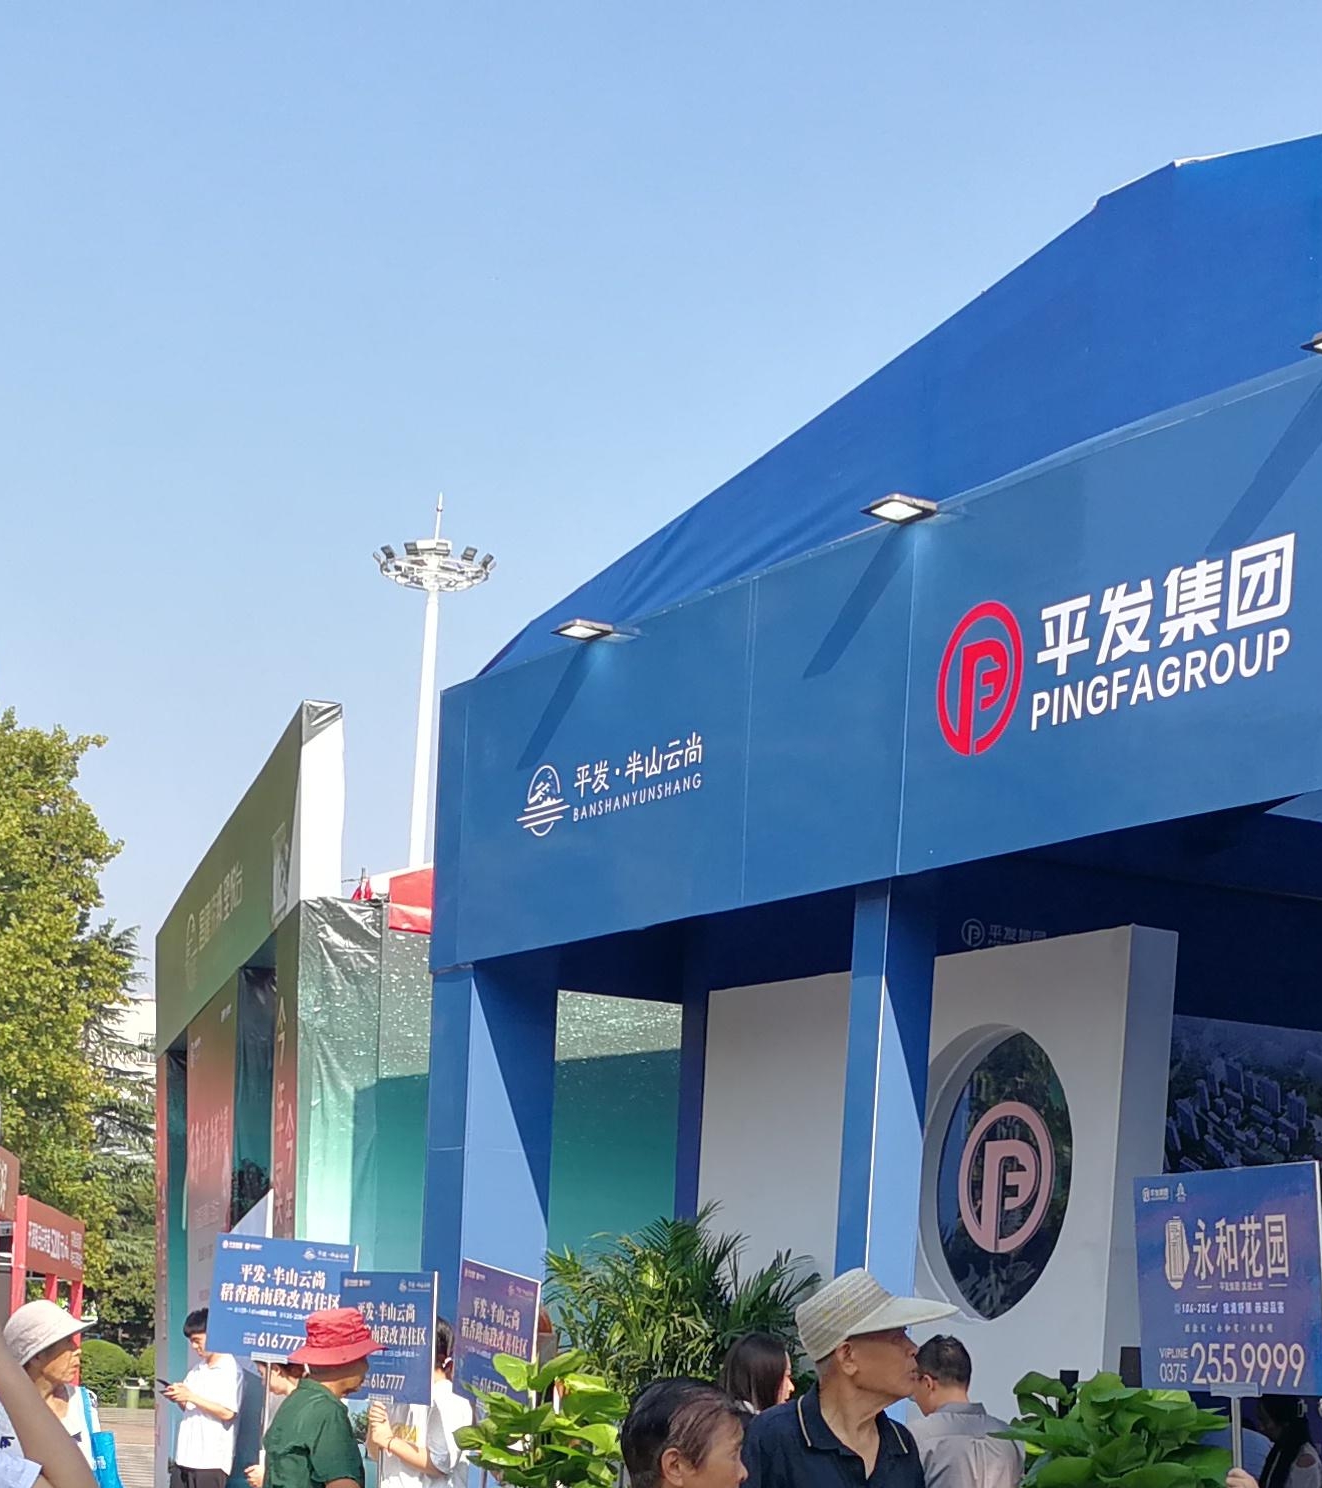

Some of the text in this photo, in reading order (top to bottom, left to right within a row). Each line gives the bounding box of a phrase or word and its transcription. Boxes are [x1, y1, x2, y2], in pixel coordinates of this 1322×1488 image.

[1036, 532, 1295, 676] 平发集团
[1030, 627, 1290, 731] PINGFAGROUP
[573, 731, 703, 798] 平发·半山云尚
[573, 773, 703, 822] BANSHANYUNSHANG
[1192, 1213, 1290, 1281] 永和花园
[239, 1263, 327, 1291] 平发·半山云尚
[220, 1282, 341, 1312] 稻香路南段改善住区
[364, 1324, 427, 1347] 南段改善住区
[1158, 1347, 1189, 1359] VIPLINE
[370, 1373, 406, 1391] 6167777
[1159, 1362, 1188, 1383] 0375
